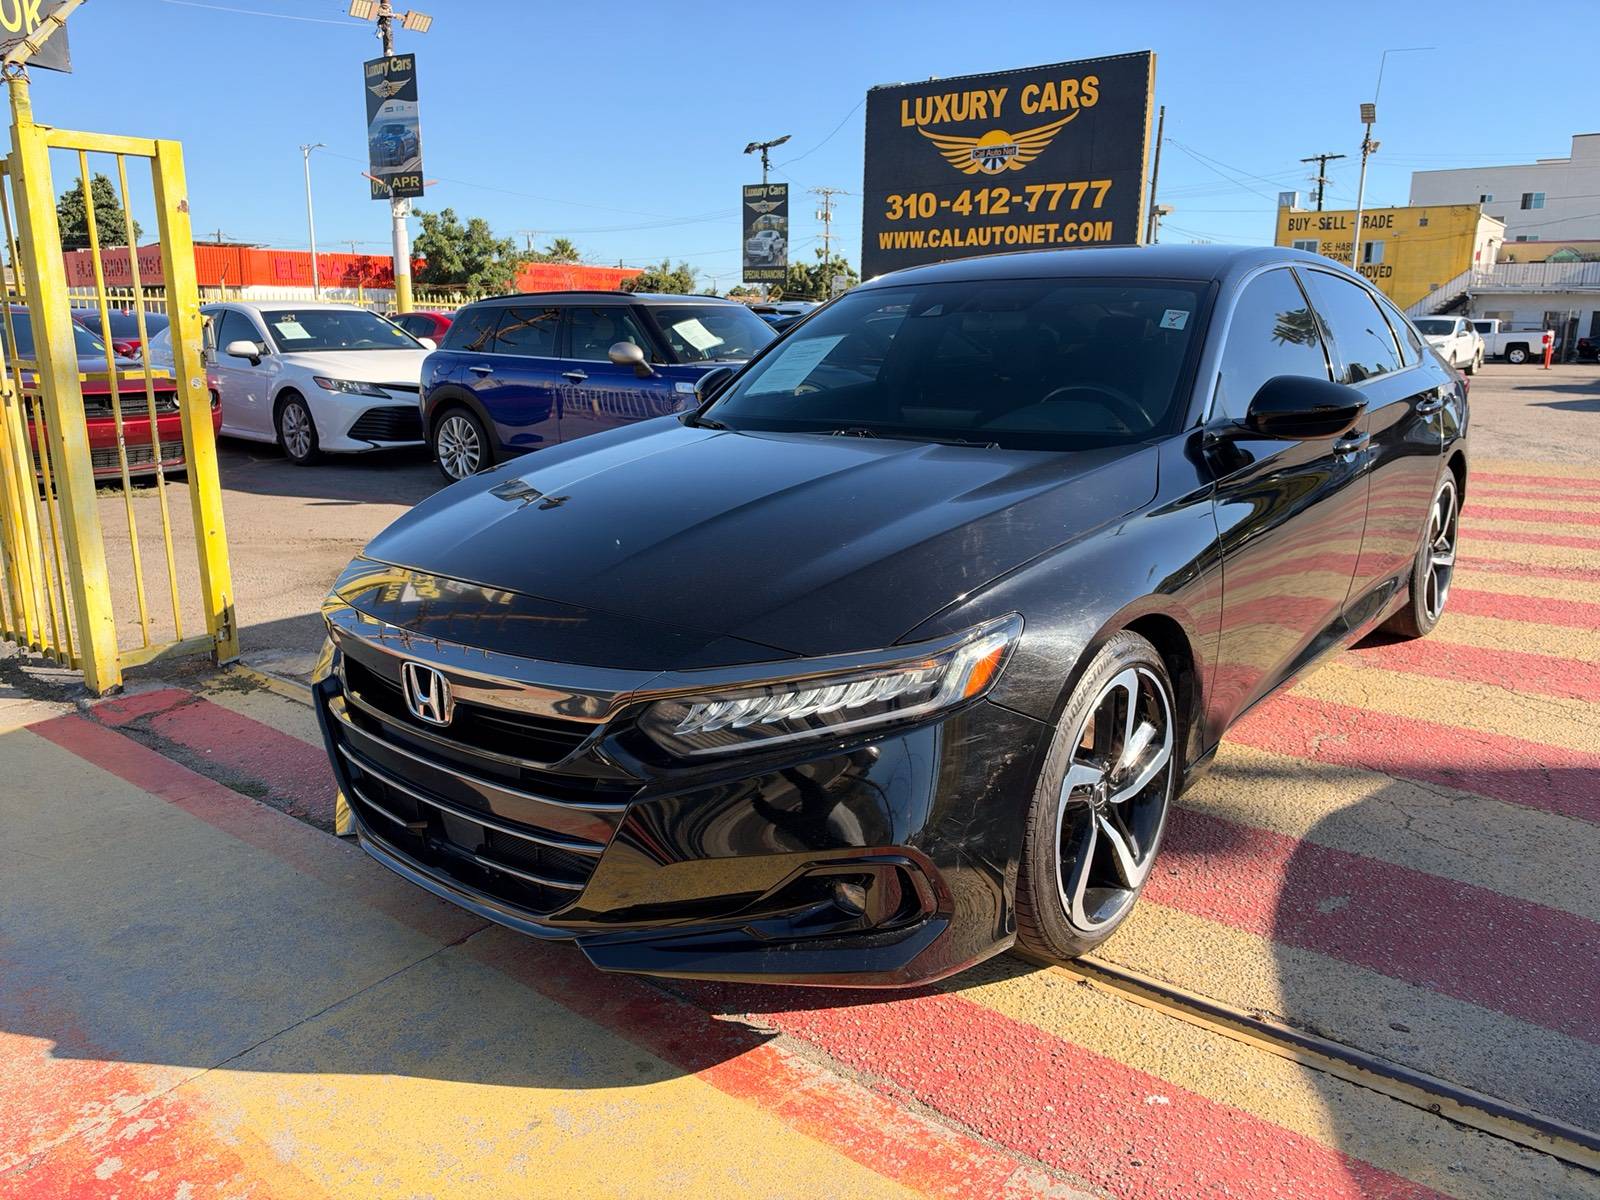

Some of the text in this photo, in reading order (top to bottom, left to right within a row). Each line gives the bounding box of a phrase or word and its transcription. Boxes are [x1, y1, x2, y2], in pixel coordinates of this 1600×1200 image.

[366, 57, 411, 77] Luxury Cars
[901, 75, 1100, 128] LUXURY CARS
[392, 176, 420, 188] APR
[744, 185, 786, 198] Luxury Cars
[885, 179, 1112, 220] 310-412-7777
[1288, 214, 1394, 231] BUY SELL RADE
[879, 221, 1113, 250] WWW.CALAUTONET.COM
[1322, 242, 1332, 252] SE
